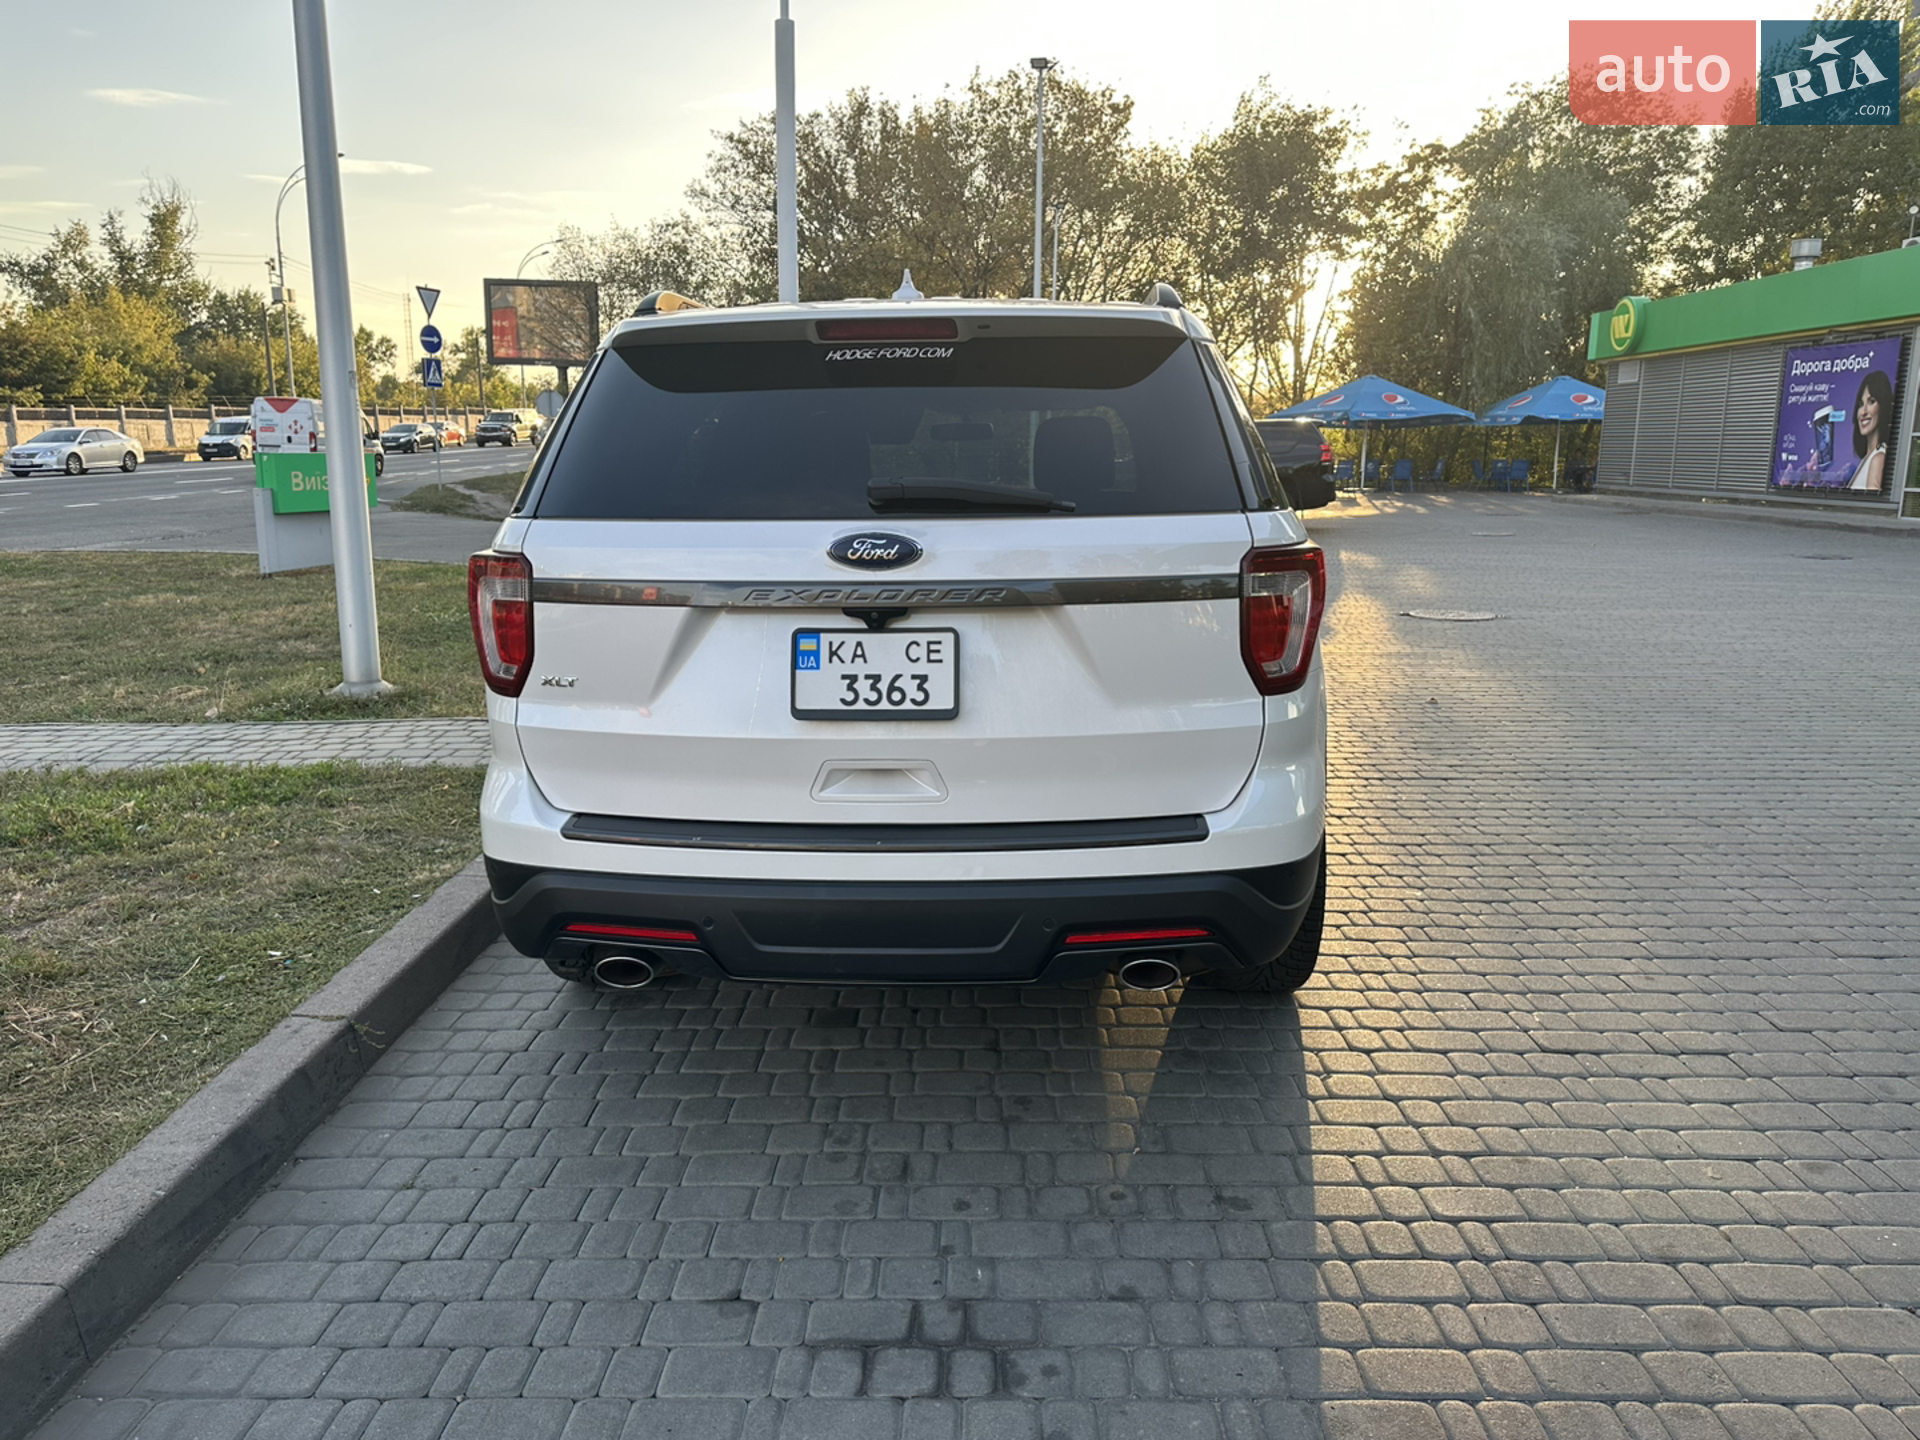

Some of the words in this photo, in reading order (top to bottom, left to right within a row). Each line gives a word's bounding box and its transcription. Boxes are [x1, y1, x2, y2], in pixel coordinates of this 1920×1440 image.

[825, 348, 878, 361] HODGE
[1791, 359, 1831, 376] Дорога
[1832, 354, 1870, 373] добра
[1814, 383, 1830, 393] каву
[291, 471, 329, 492] Виїз
[847, 538, 900, 562] Ford
[742, 587, 1009, 604] EXPLORER
[828, 640, 868, 664] KA
[904, 640, 944, 664] CE
[799, 655, 817, 669] UA
[540, 675, 579, 688] XLT
[839, 673, 931, 707] 3363
